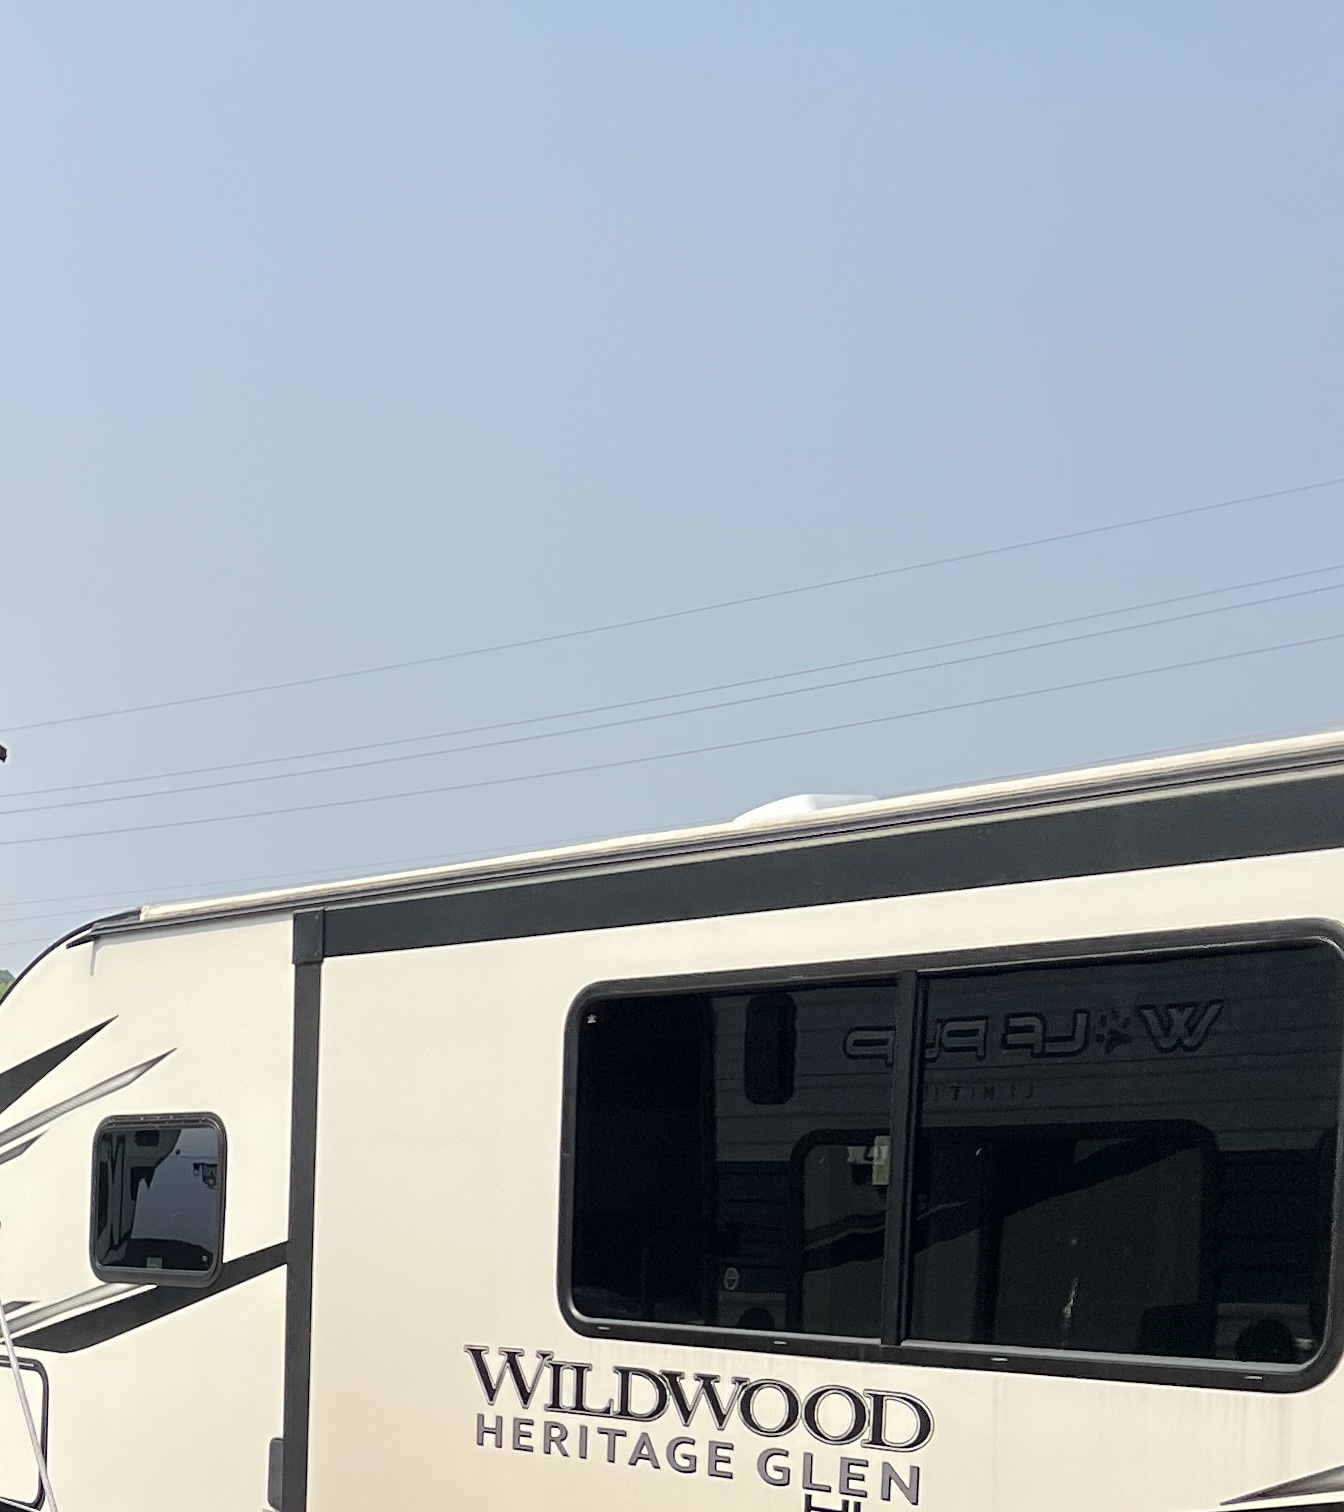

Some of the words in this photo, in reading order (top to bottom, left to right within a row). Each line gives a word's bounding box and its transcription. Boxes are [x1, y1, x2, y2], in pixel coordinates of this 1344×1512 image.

[463, 1344, 936, 1454] WILDWOOD
[476, 1413, 735, 1480] HERITAGE
[756, 1447, 921, 1506] GLEN
